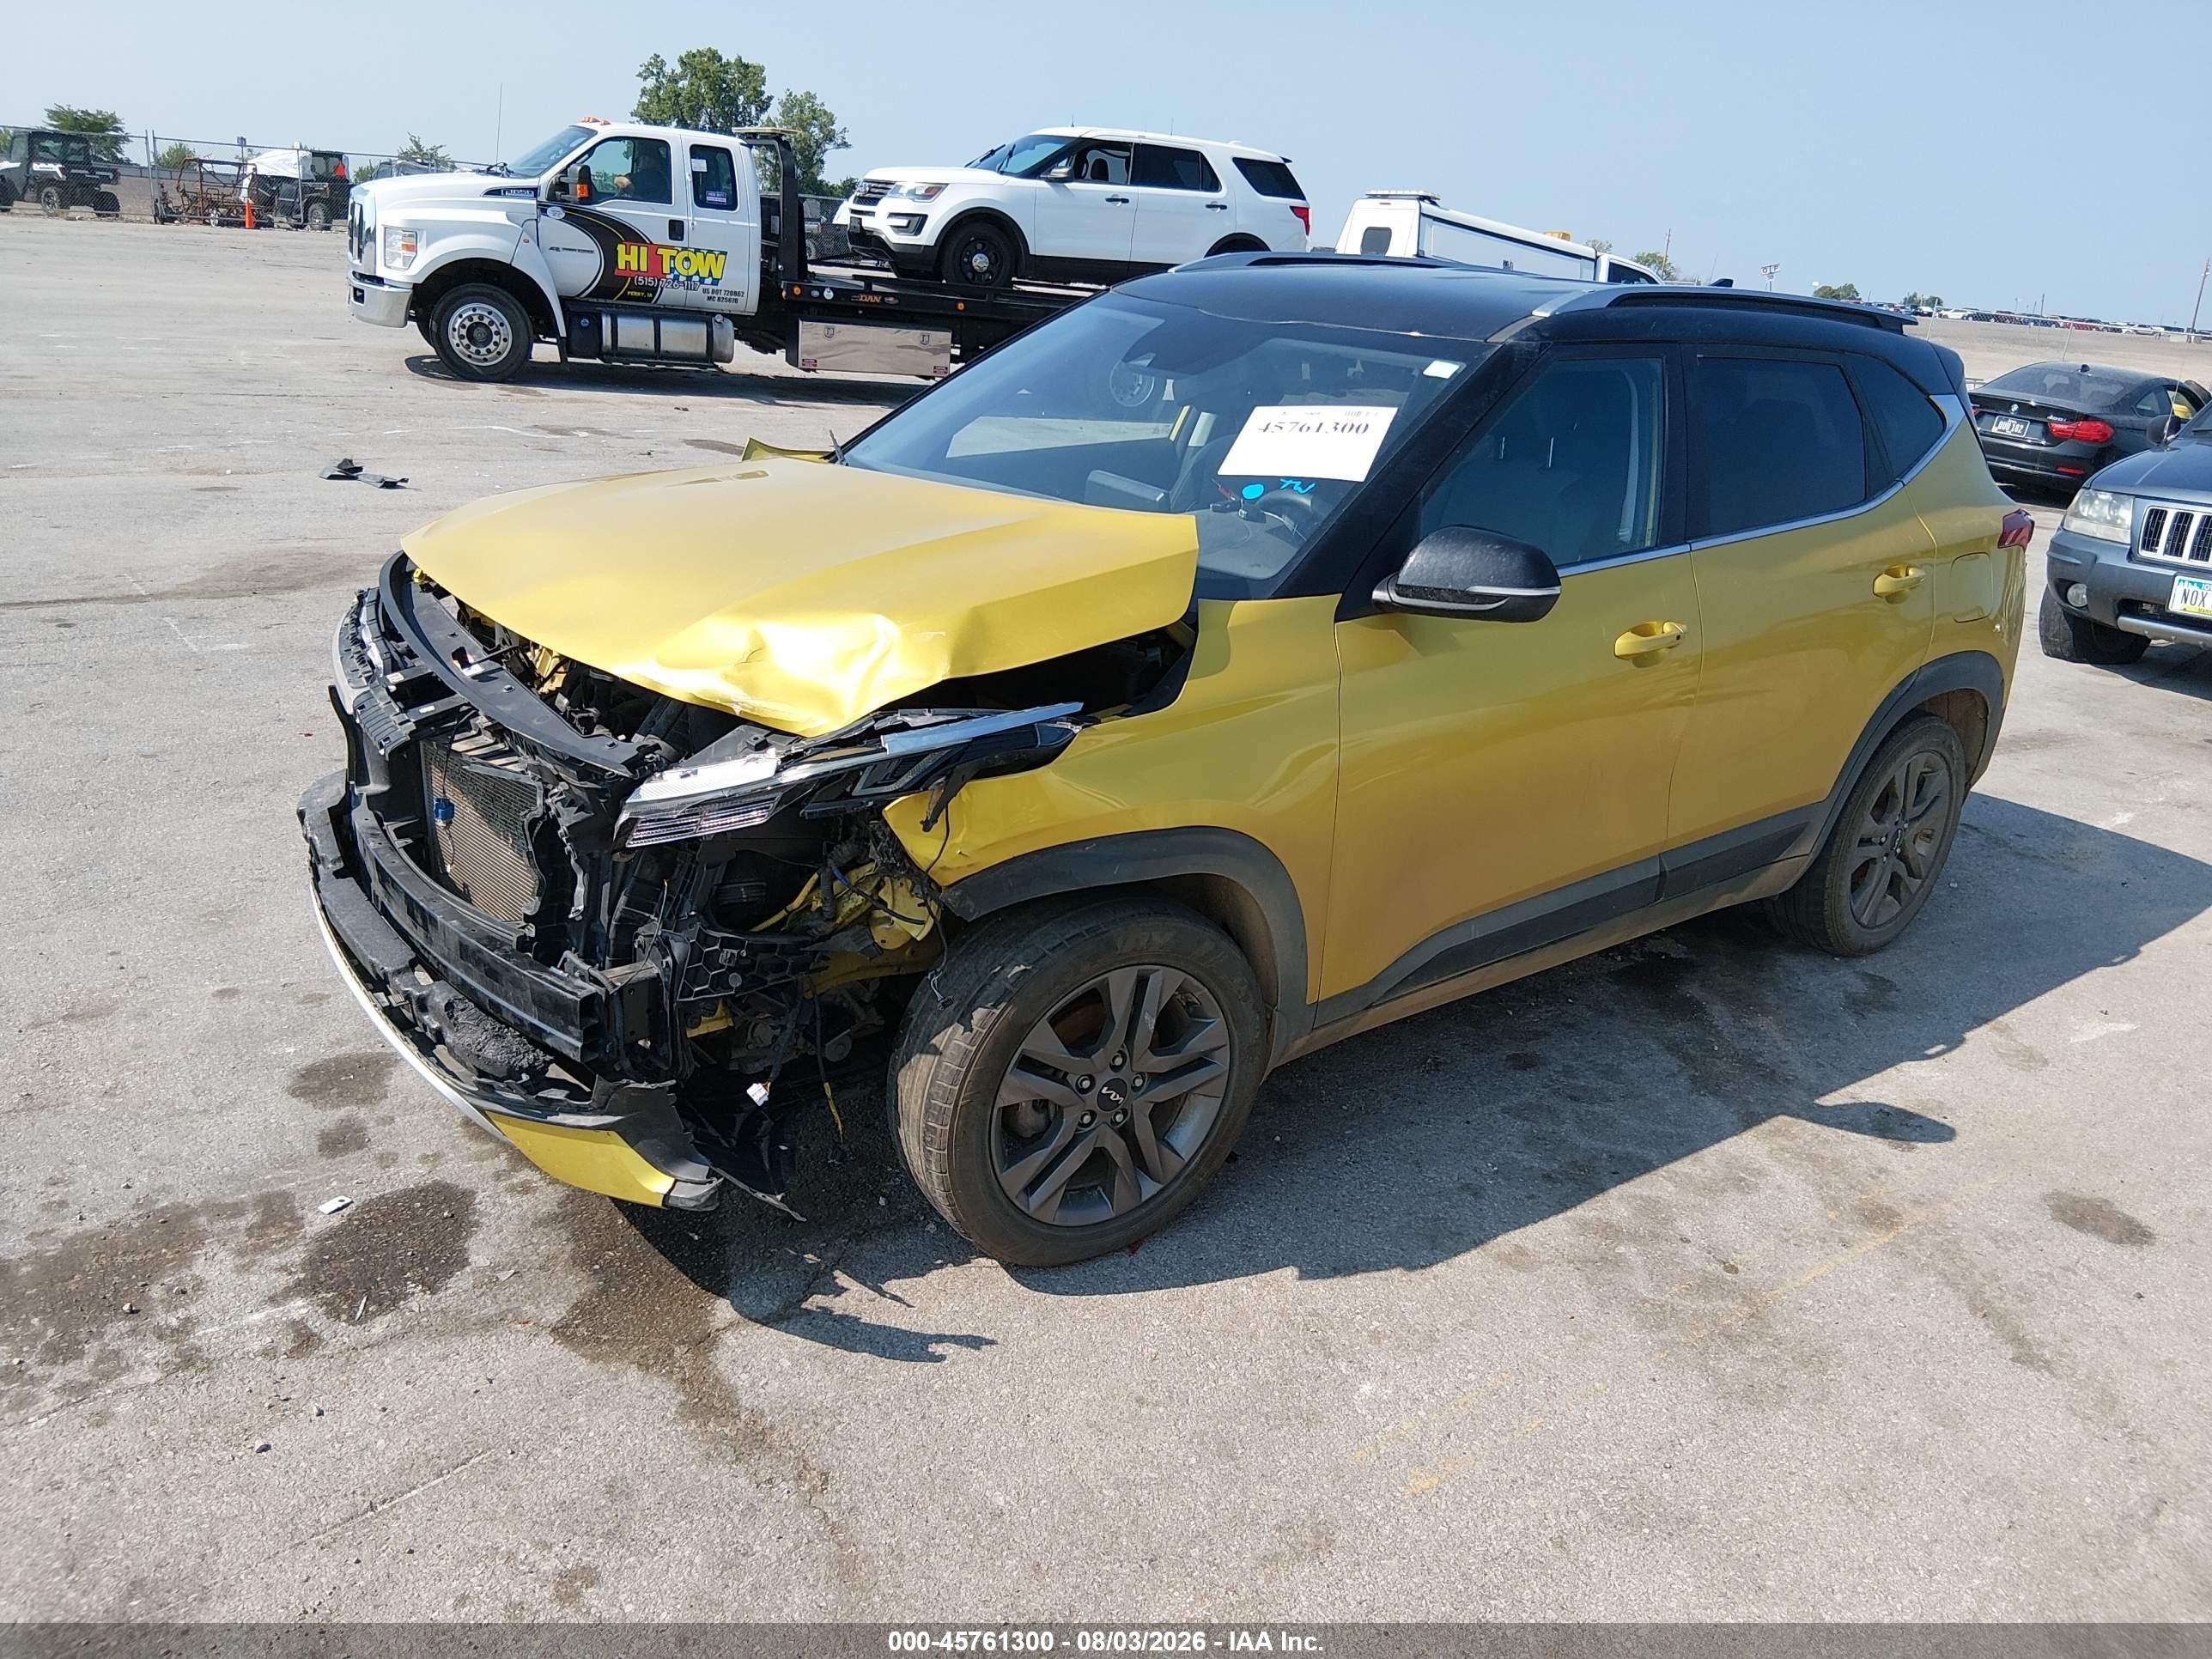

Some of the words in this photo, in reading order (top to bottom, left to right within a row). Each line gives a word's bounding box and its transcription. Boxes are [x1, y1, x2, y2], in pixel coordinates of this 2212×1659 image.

[617, 243, 648, 272] HI
[657, 247, 726, 279] TOW
[634, 275, 658, 288] (515)
[659, 277, 701, 292] 726-1117
[1257, 422, 1369, 434] 45761300
[2180, 588, 2208, 607] NOX
